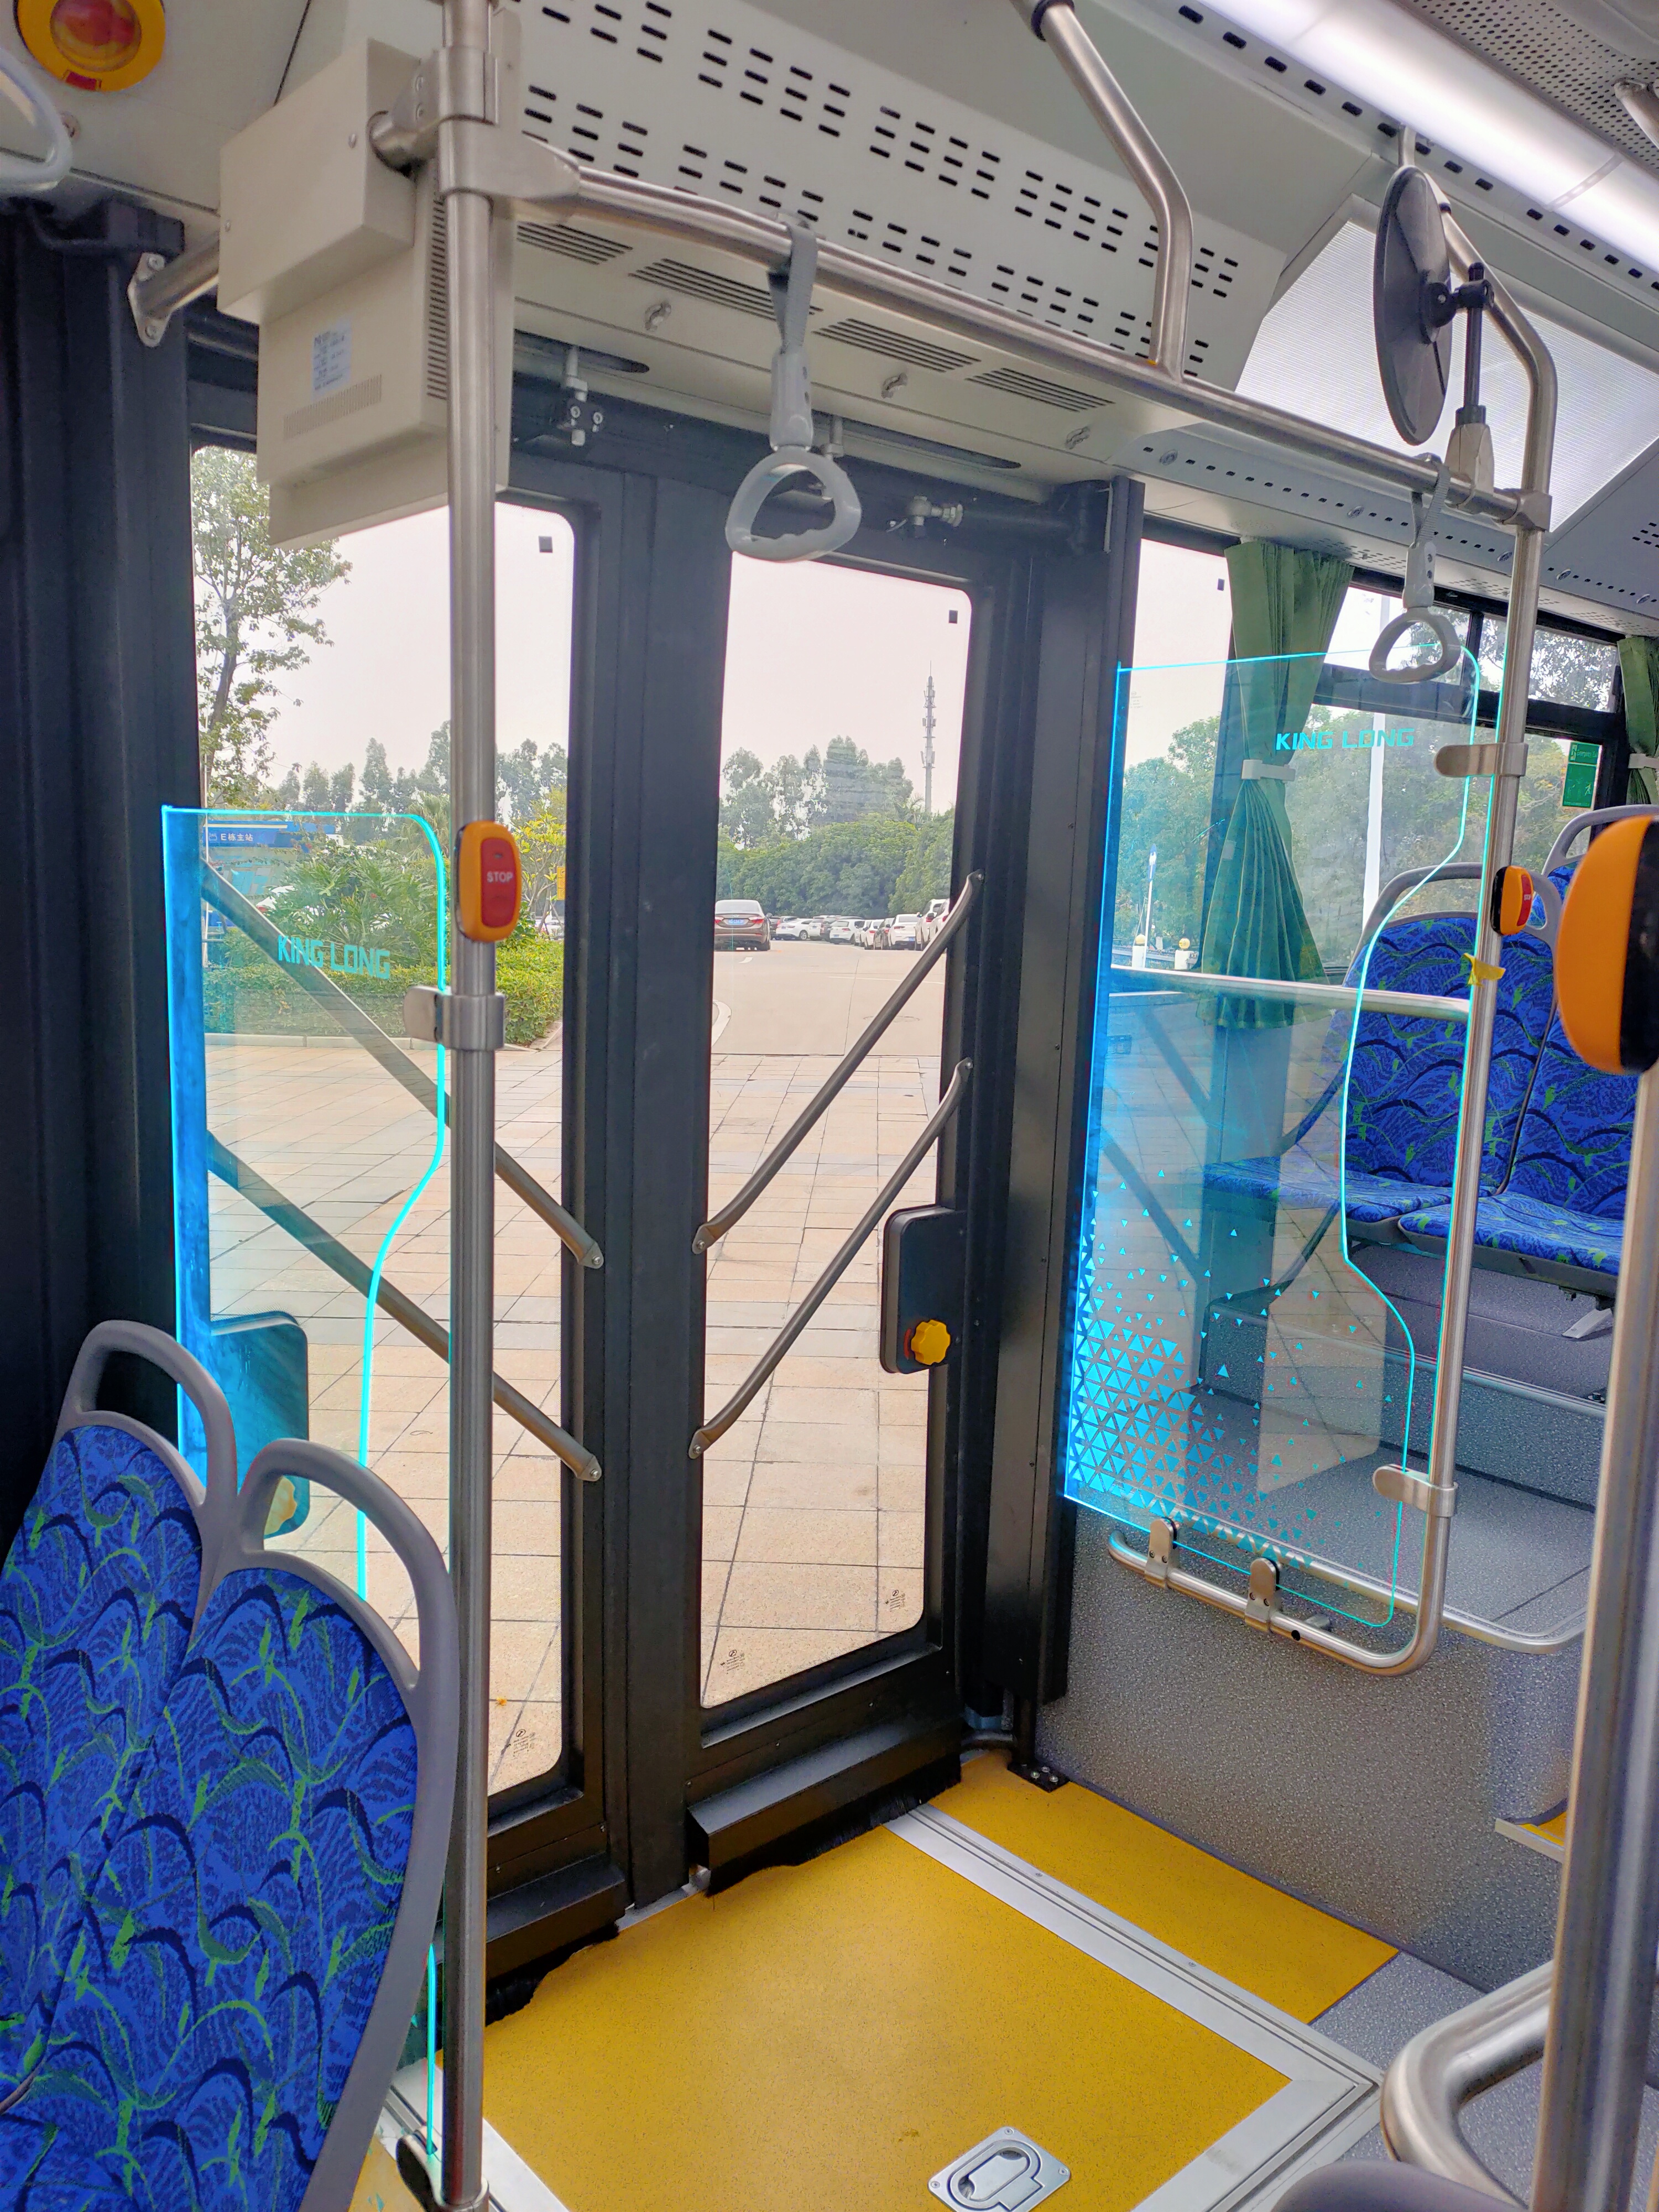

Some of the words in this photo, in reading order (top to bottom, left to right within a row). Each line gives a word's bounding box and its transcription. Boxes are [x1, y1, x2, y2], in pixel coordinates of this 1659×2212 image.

[1276, 731, 1333, 750] KING
[1342, 728, 1415, 748] LONG
[487, 870, 513, 883] STOP
[278, 935, 324, 968] KING
[330, 942, 390, 979] LONG
